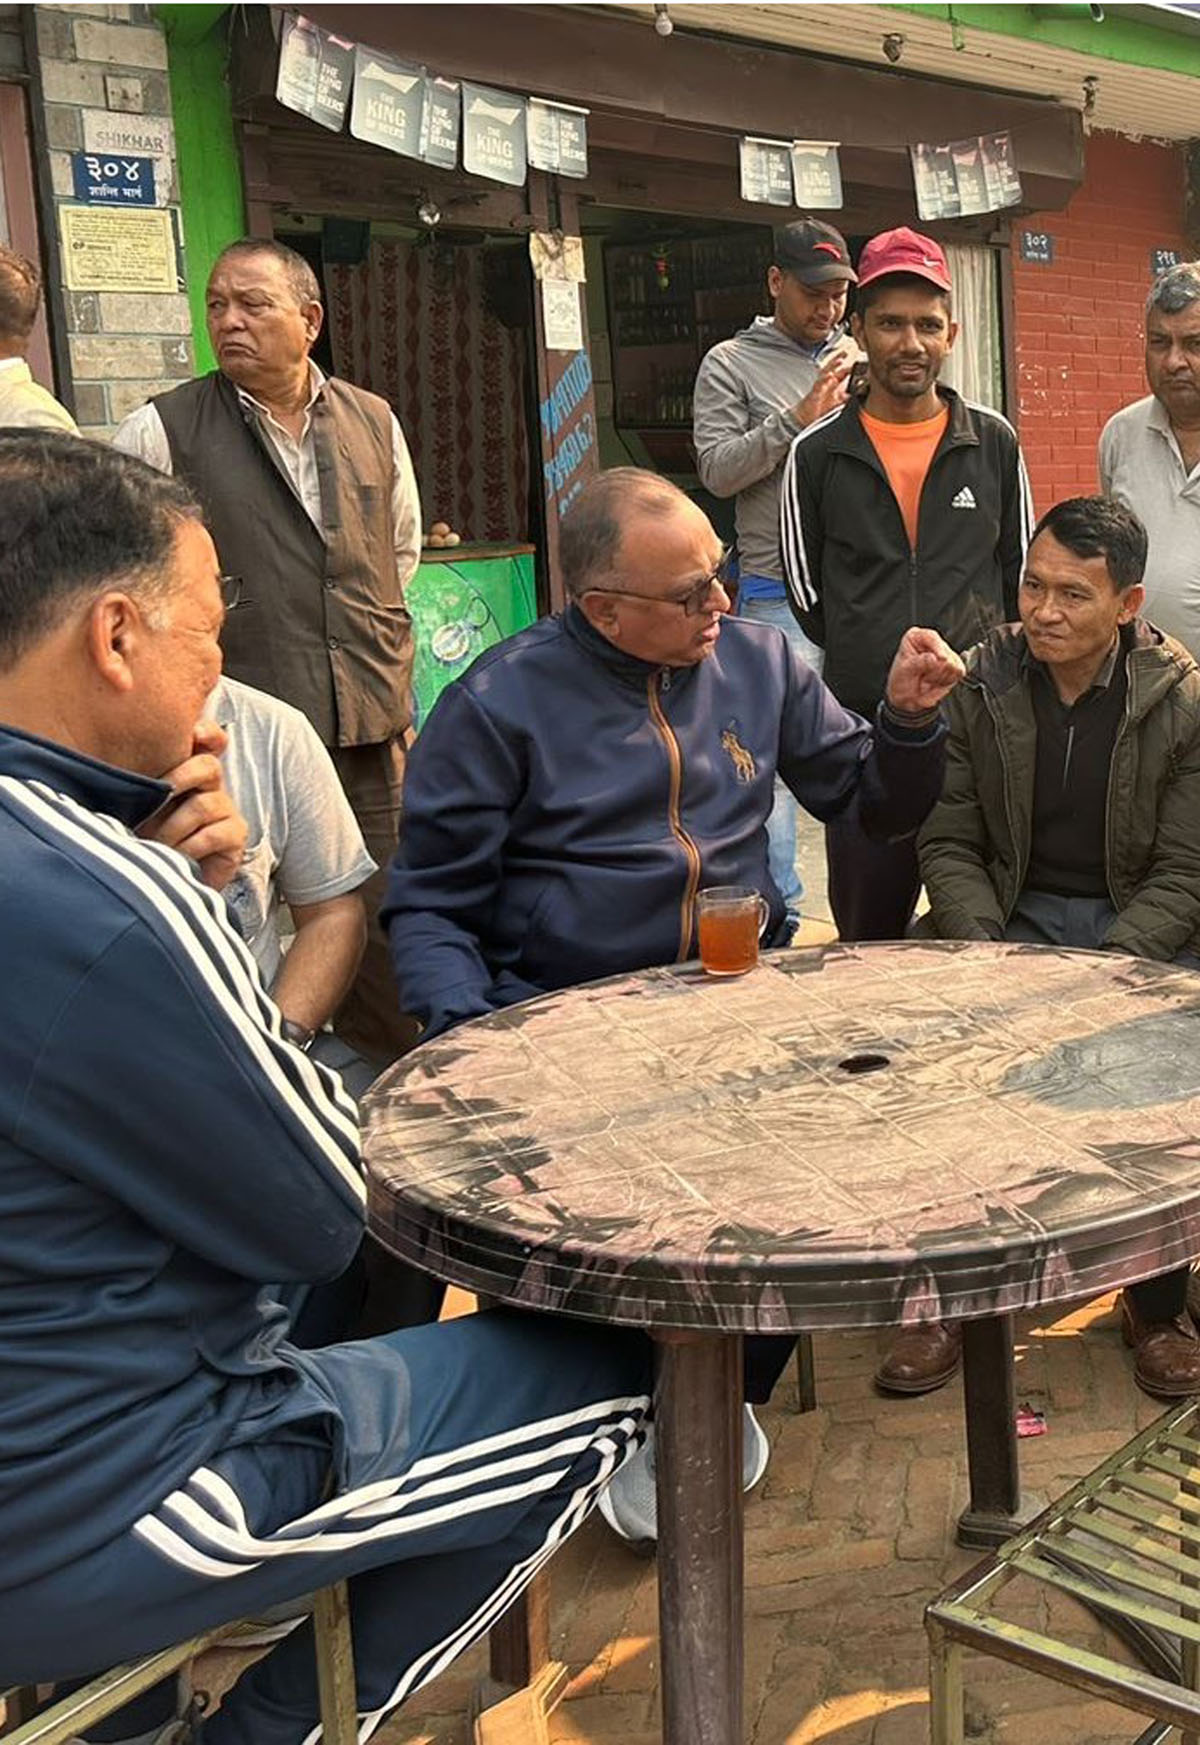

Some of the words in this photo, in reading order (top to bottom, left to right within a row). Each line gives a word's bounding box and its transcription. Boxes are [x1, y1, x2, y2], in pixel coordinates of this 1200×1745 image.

[320, 62, 340, 78] THE
[318, 73, 343, 92] KING
[316, 95, 346, 114] BEERS
[366, 99, 407, 127] KING
[431, 104, 449, 118] THE
[96, 131, 164, 150] SHIKHAR
[429, 134, 458, 151] BEERS
[476, 133, 513, 159] KING
[84, 156, 140, 182] ३०४
[1025, 232, 1048, 250] ३०२
